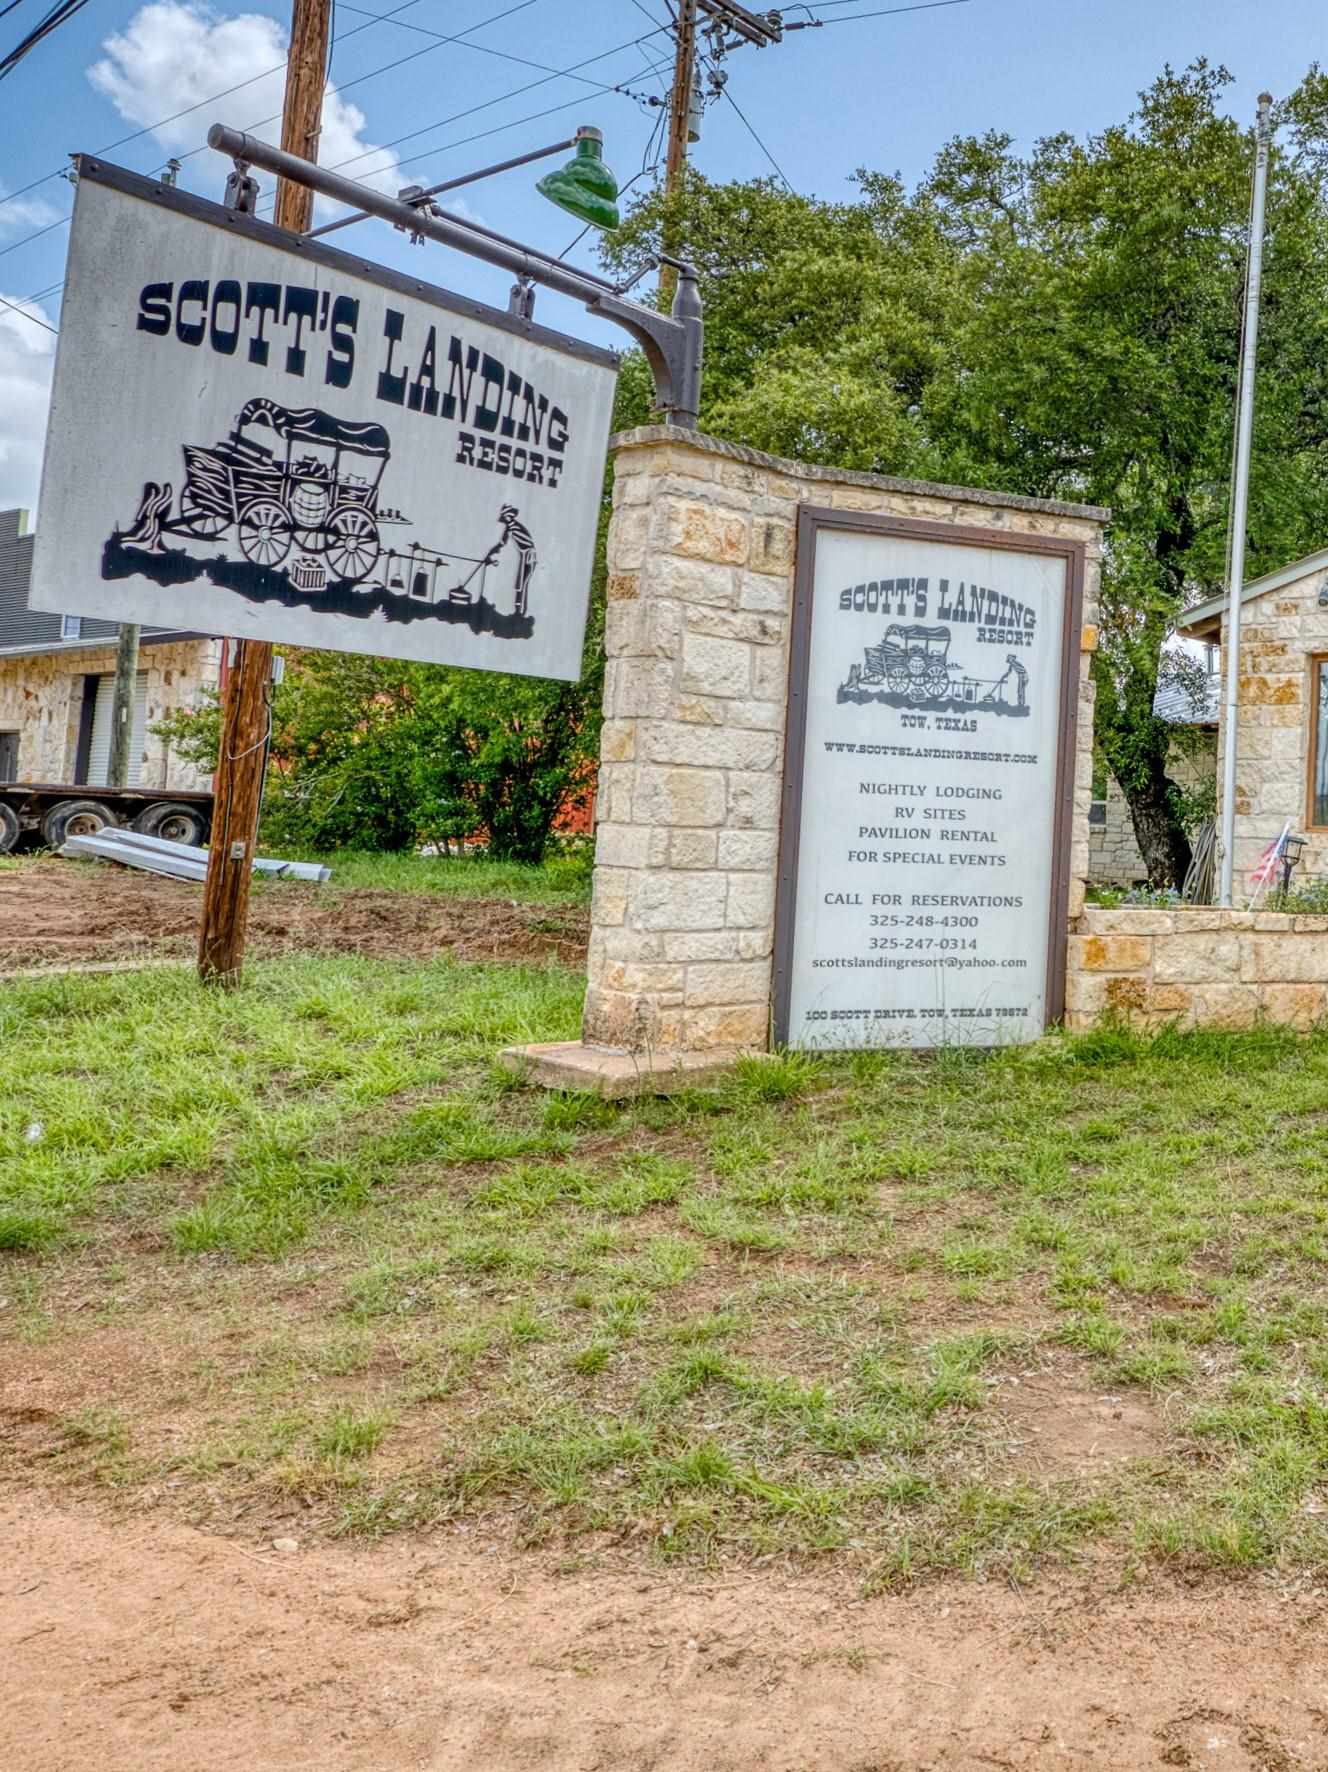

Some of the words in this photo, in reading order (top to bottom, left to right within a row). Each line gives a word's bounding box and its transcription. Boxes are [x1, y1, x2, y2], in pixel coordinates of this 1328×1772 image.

[137, 280, 360, 389] SCOTT'S
[377, 309, 569, 451] LANDING
[456, 431, 564, 488] RESORT
[839, 578, 928, 618] SCOTT'S
[937, 579, 1036, 629] LANDING
[976, 627, 1034, 647] RESORT
[901, 714, 931, 731] TOW,
[936, 717, 977, 732] TEXAS
[824, 741, 1038, 764] WWW.SCOTTSLANDINGRESORT.COM
[859, 782, 927, 797] NIGHTLY
[935, 786, 1003, 800] LODGING
[895, 807, 915, 819] RV
[923, 808, 966, 821] SITES
[859, 827, 931, 840] PAVILION
[940, 830, 998, 843] RENTAL
[848, 850, 878, 863] FOR
[882, 851, 945, 865] SPECIAL
[949, 854, 1007, 866] EVENTS
[824, 893, 863, 906] CALL
[872, 894, 902, 906] FOR
[911, 894, 1024, 908] RESERVATIONS
[869, 915, 979, 928] 325-248-4300
[869, 938, 977, 950] 325-247-0314
[812, 957, 1028, 970] scottslandingresort@yahoo.com
[805, 1011, 828, 1020] 100
[830, 1010, 871, 1020] SCOTT
[951, 1008, 992, 1018] TEXAS
